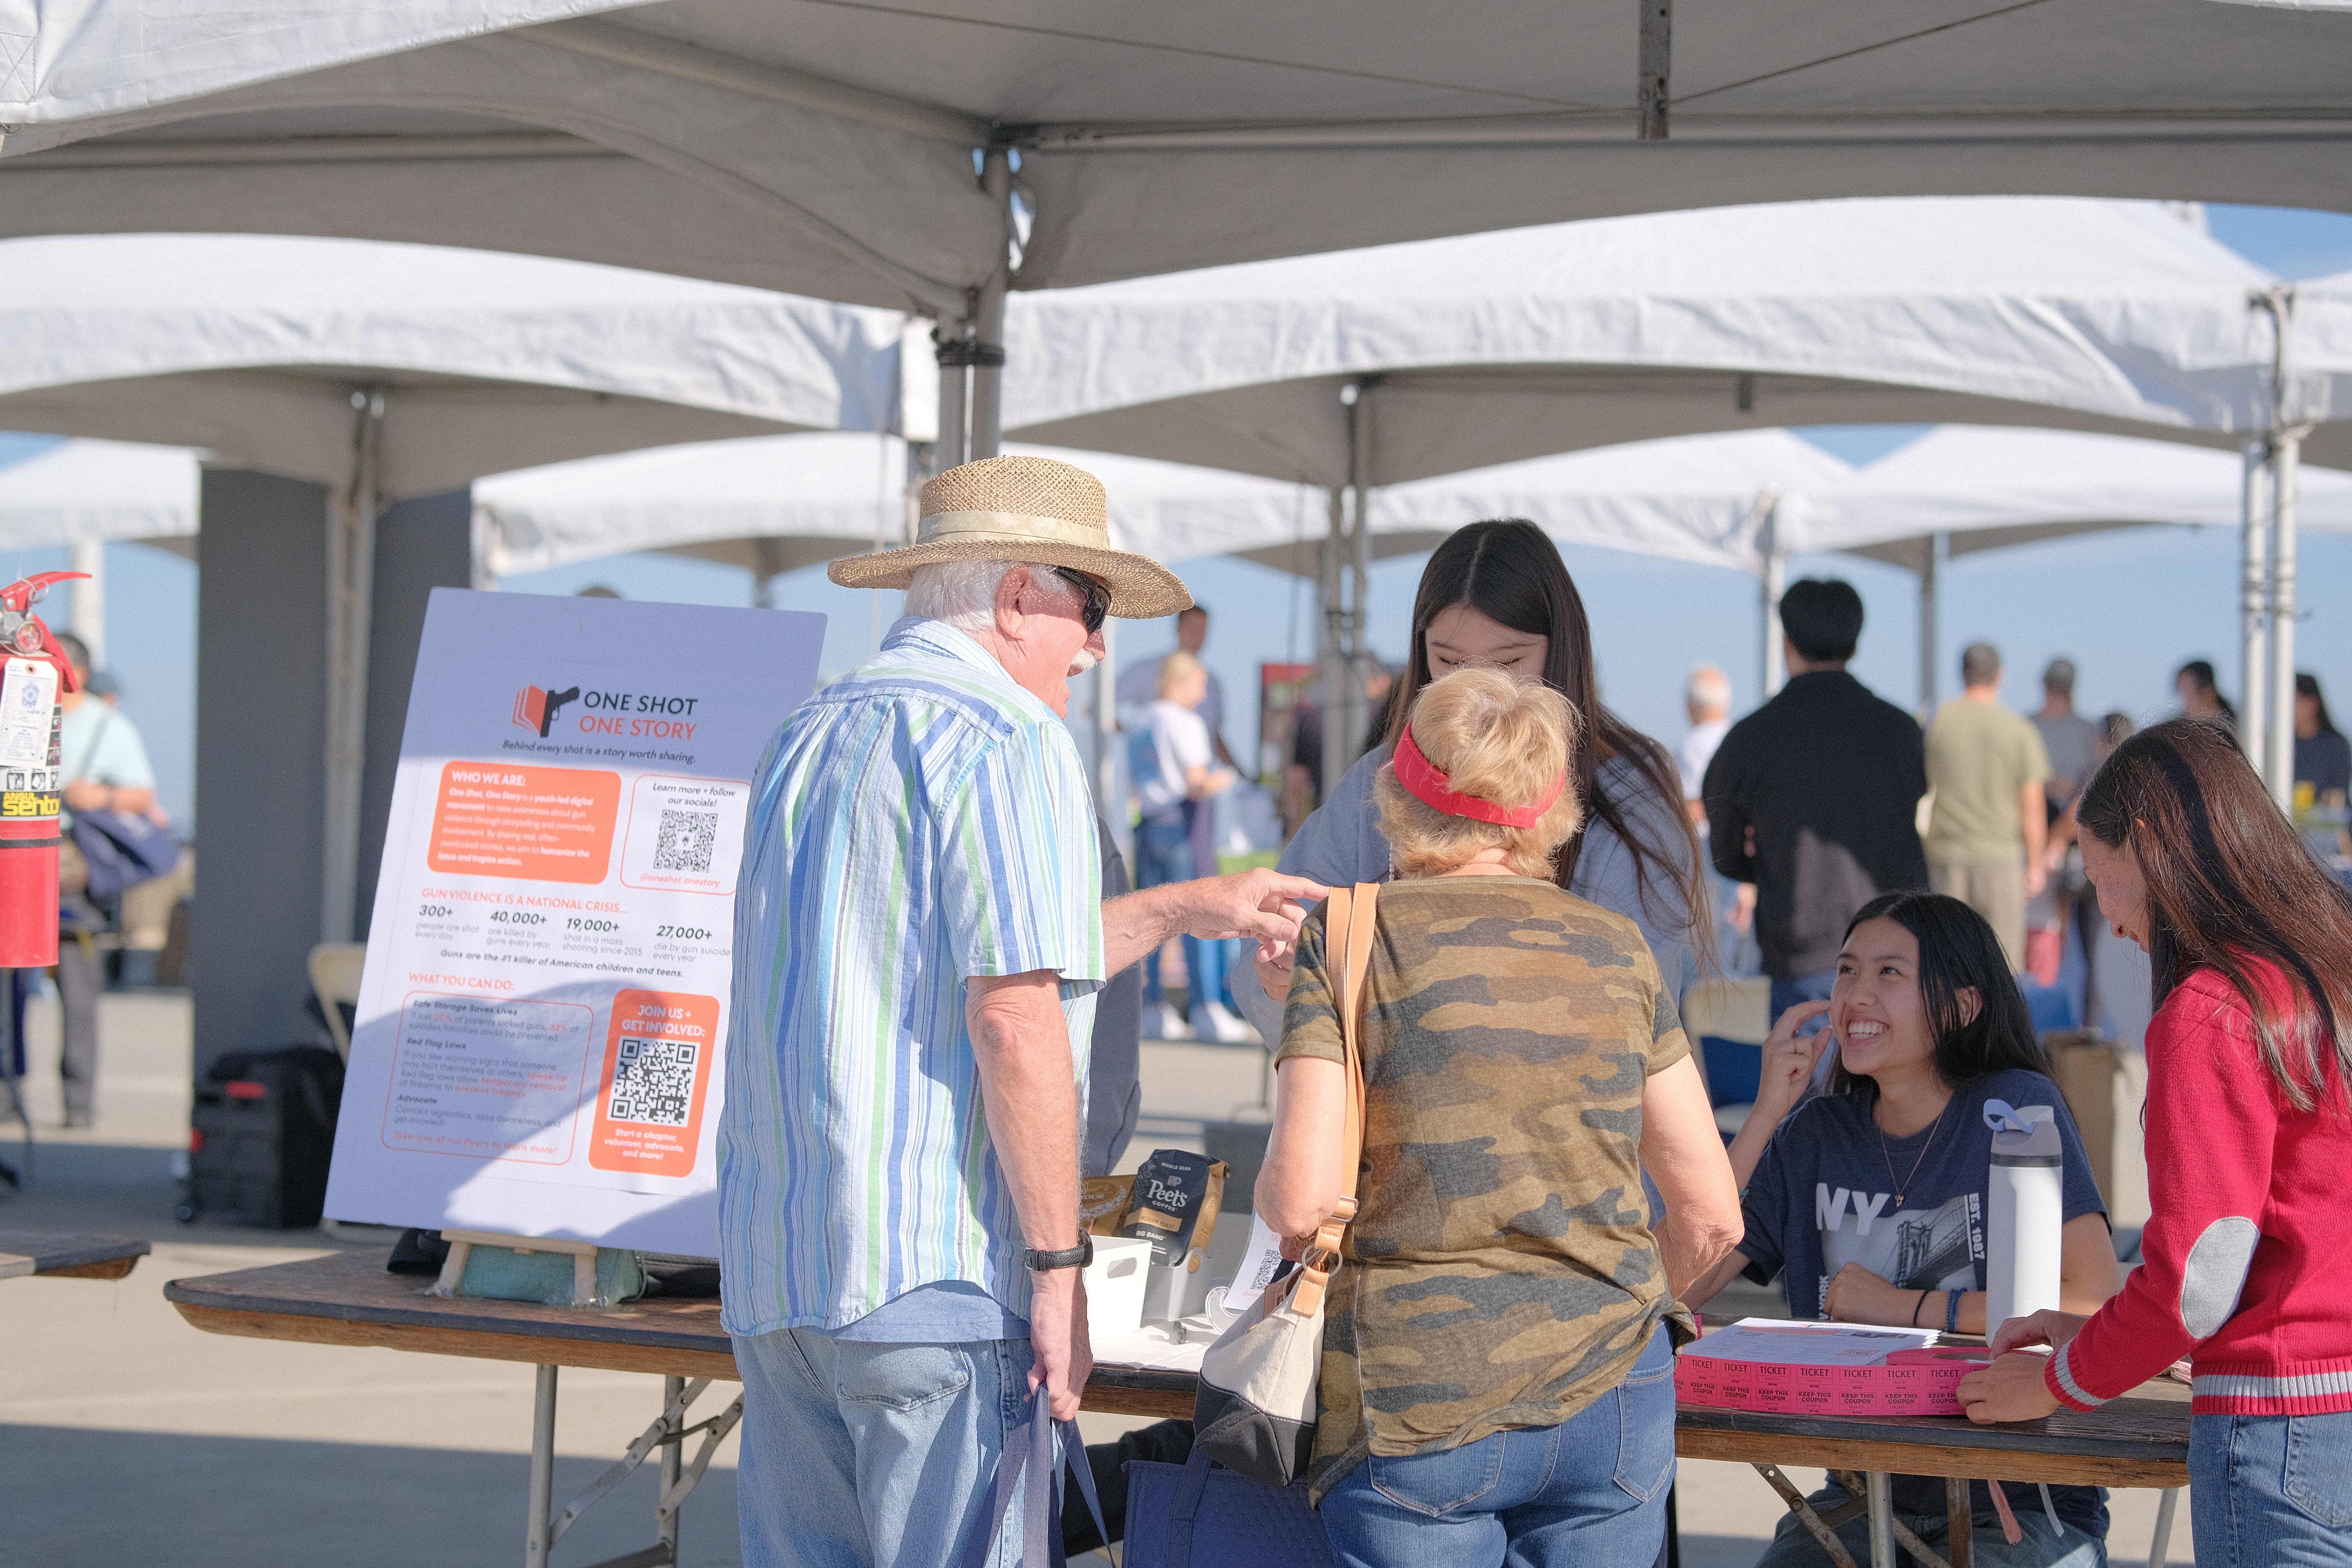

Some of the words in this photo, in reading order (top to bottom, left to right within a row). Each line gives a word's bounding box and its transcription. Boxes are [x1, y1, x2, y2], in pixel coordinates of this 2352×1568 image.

[585, 692, 631, 710] ONE
[637, 696, 698, 715] SHOT
[580, 715, 625, 735] ONE
[630, 719, 697, 739] STORY
[502, 740, 535, 751] Behind
[537, 744, 561, 754] every
[564, 744, 583, 754] shot
[585, 746, 593, 755] is
[603, 747, 626, 759] story
[629, 748, 656, 759] worth
[658, 751, 696, 764] sharing.
[452, 771, 481, 783] WHO
[483, 772, 501, 784] WE
[502, 773, 526, 787] ARE:
[653, 783, 676, 792] Learn
[709, 787, 736, 796] follow
[449, 787, 465, 797] One
[486, 790, 501, 799] One
[502, 791, 521, 802] Story
[570, 796, 594, 807] digital
[684, 798, 717, 807] socials!
[422, 887, 447, 899] GUN
[449, 890, 502, 903] VIOLENCE
[505, 894, 514, 904] IS
[516, 896, 524, 905] A
[526, 896, 582, 910] NATIONAL
[419, 905, 453, 917] 300+
[491, 911, 547, 925] 40,000+
[416, 922, 444, 931] people
[462, 925, 479, 933] shot
[567, 918, 620, 932] 19,000+
[415, 932, 436, 940] every
[504, 927, 525, 937] killed
[527, 930, 537, 939] by
[564, 934, 582, 942] shot
[656, 925, 712, 940] 27,000+
[562, 943, 597, 954] shooting
[600, 946, 622, 954] since
[624, 947, 643, 956] 2015
[669, 943, 680, 953] by
[700, 947, 730, 957] suicide
[441, 949, 462, 959] Guns
[484, 952, 498, 961] the
[513, 955, 536, 965] killer
[539, 957, 548, 966] of
[549, 959, 593, 970] American
[596, 963, 633, 973] children
[636, 966, 654, 974] and
[657, 968, 683, 977] teens.
[653, 953, 675, 962] every
[409, 972, 440, 984] WHAT
[443, 975, 466, 986] YOU
[468, 977, 492, 988] CAN
[495, 979, 515, 991] DO:
[638, 1004, 666, 1018] JOIN
[668, 1008, 684, 1019] US
[622, 1019, 645, 1031] GET
[645, 1021, 706, 1037] INVOLVED:
[615, 1128, 634, 1137] Start
[643, 1130, 677, 1142] chapter,
[640, 1152, 665, 1160] more!
[1147, 1179, 1188, 1207] Peet's
[1152, 1200, 1177, 1212] COFFEE
[1816, 1182, 1890, 1236] NY
[1969, 1193, 1980, 1223] EST.
[1972, 1227, 1985, 1260] 1987
[1692, 1359, 1713, 1369] TICKET
[1724, 1363, 1747, 1373] TICKET
[1759, 1366, 1787, 1375] TICKET
[1801, 1368, 1829, 1377] TICKET
